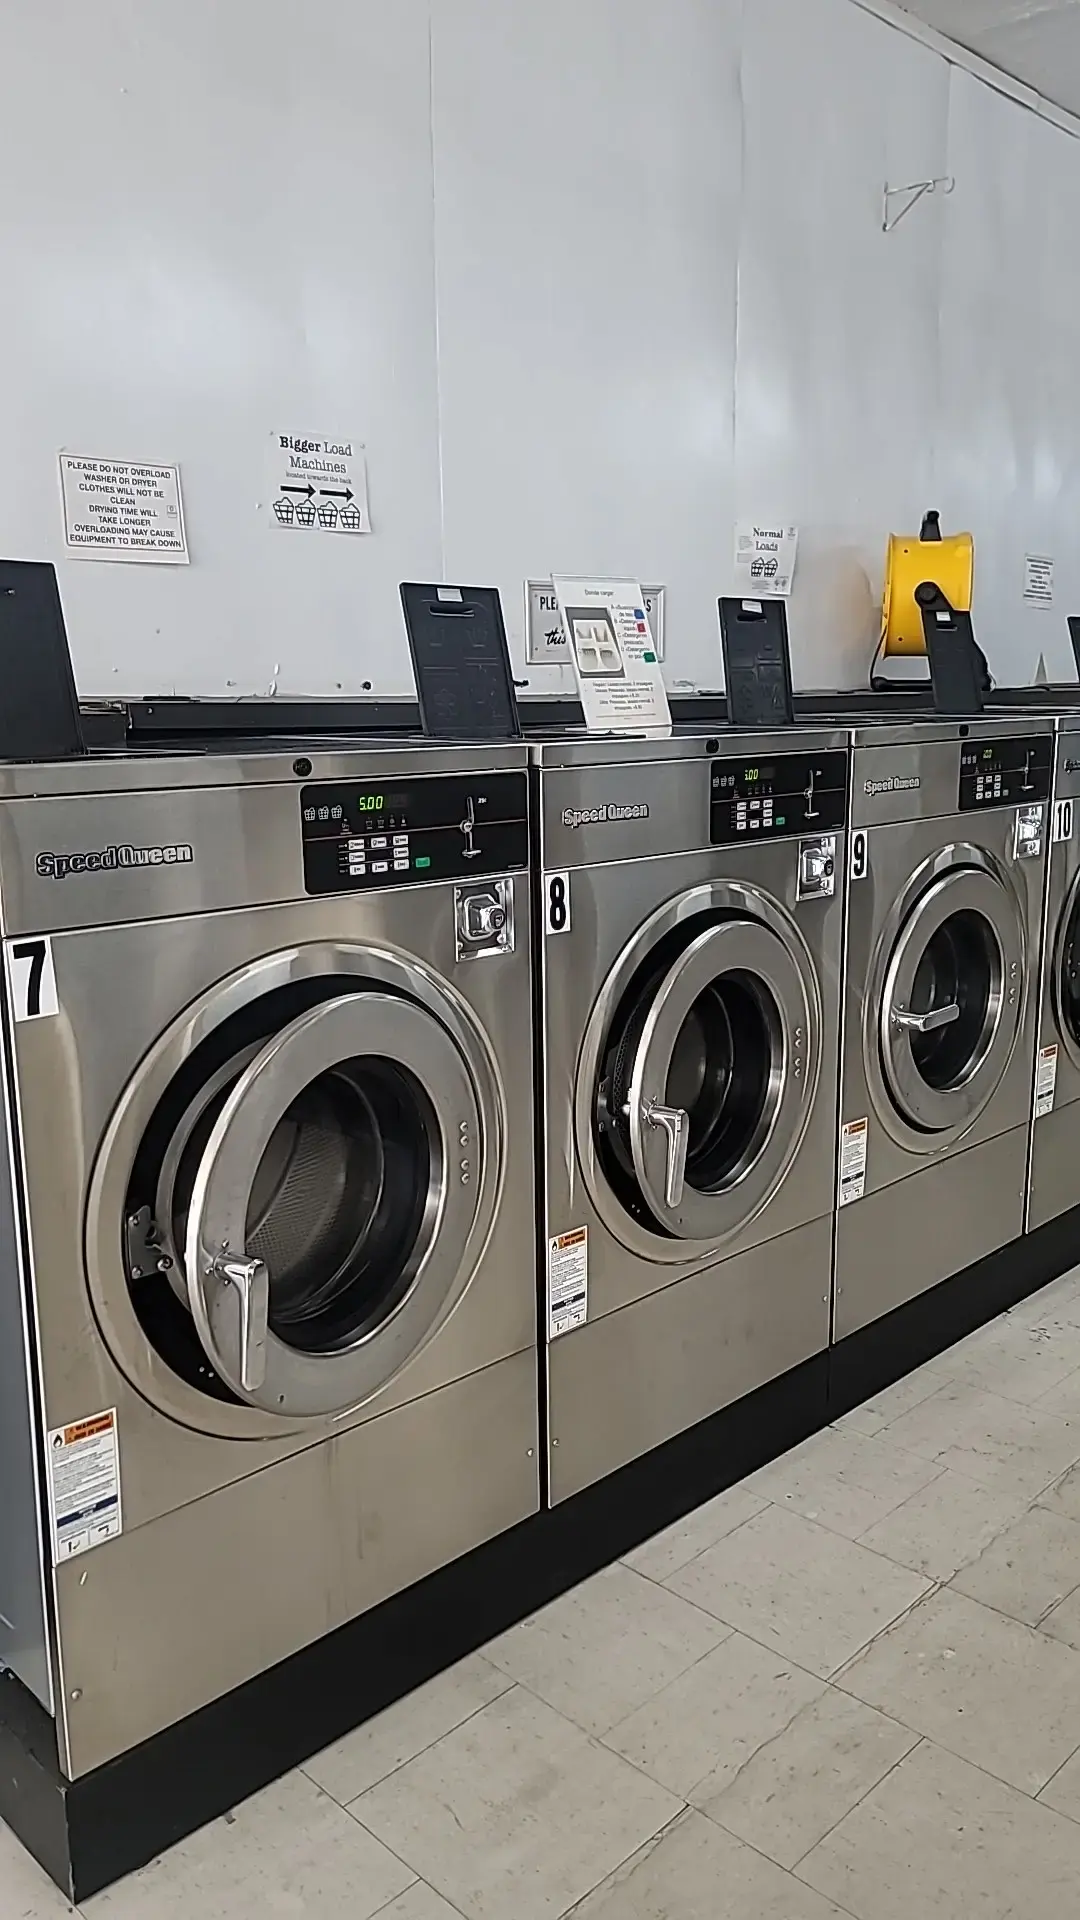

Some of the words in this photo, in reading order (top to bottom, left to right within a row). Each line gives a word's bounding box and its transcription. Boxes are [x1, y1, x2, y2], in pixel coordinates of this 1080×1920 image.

[279, 436, 321, 453] Bigger
[324, 442, 352, 456] Load
[67, 461, 98, 471] PLEASE
[100, 464, 111, 473] DO
[113, 466, 128, 475] NOT
[130, 468, 171, 478] OVERLOAD
[289, 456, 346, 473] Machines
[84, 474, 117, 484] WASHER
[132, 478, 157, 487] DRYER
[286, 471, 306, 480] located
[307, 473, 329, 482] towards
[79, 484, 115, 494] CLOTHES
[116, 487, 134, 496] WILL
[136, 489, 152, 497] NOT
[154, 490, 164, 498] BE
[110, 497, 136, 505] CLEAN
[89, 505, 118, 514] DRYING
[120, 507, 138, 515] TIME
[98, 516, 118, 524] TAKE
[120, 518, 151, 526] LONGER
[74, 524, 130, 535] OVERLOADING
[132, 528, 148, 536] MAY
[150, 530, 175, 538] CAUSE
[753, 527, 783, 538] Normal
[70, 534, 116, 544] EQUIPMENT
[118, 537, 128, 545] TO
[131, 538, 156, 546] BREAK
[158, 540, 181, 548] DOWN
[756, 541, 778, 551] Loads
[544, 627, 566, 645] this
[1057, 801, 1072, 840] 10
[854, 833, 865, 877] 9
[550, 876, 566, 930] 8
[13, 940, 46, 1016] 7
